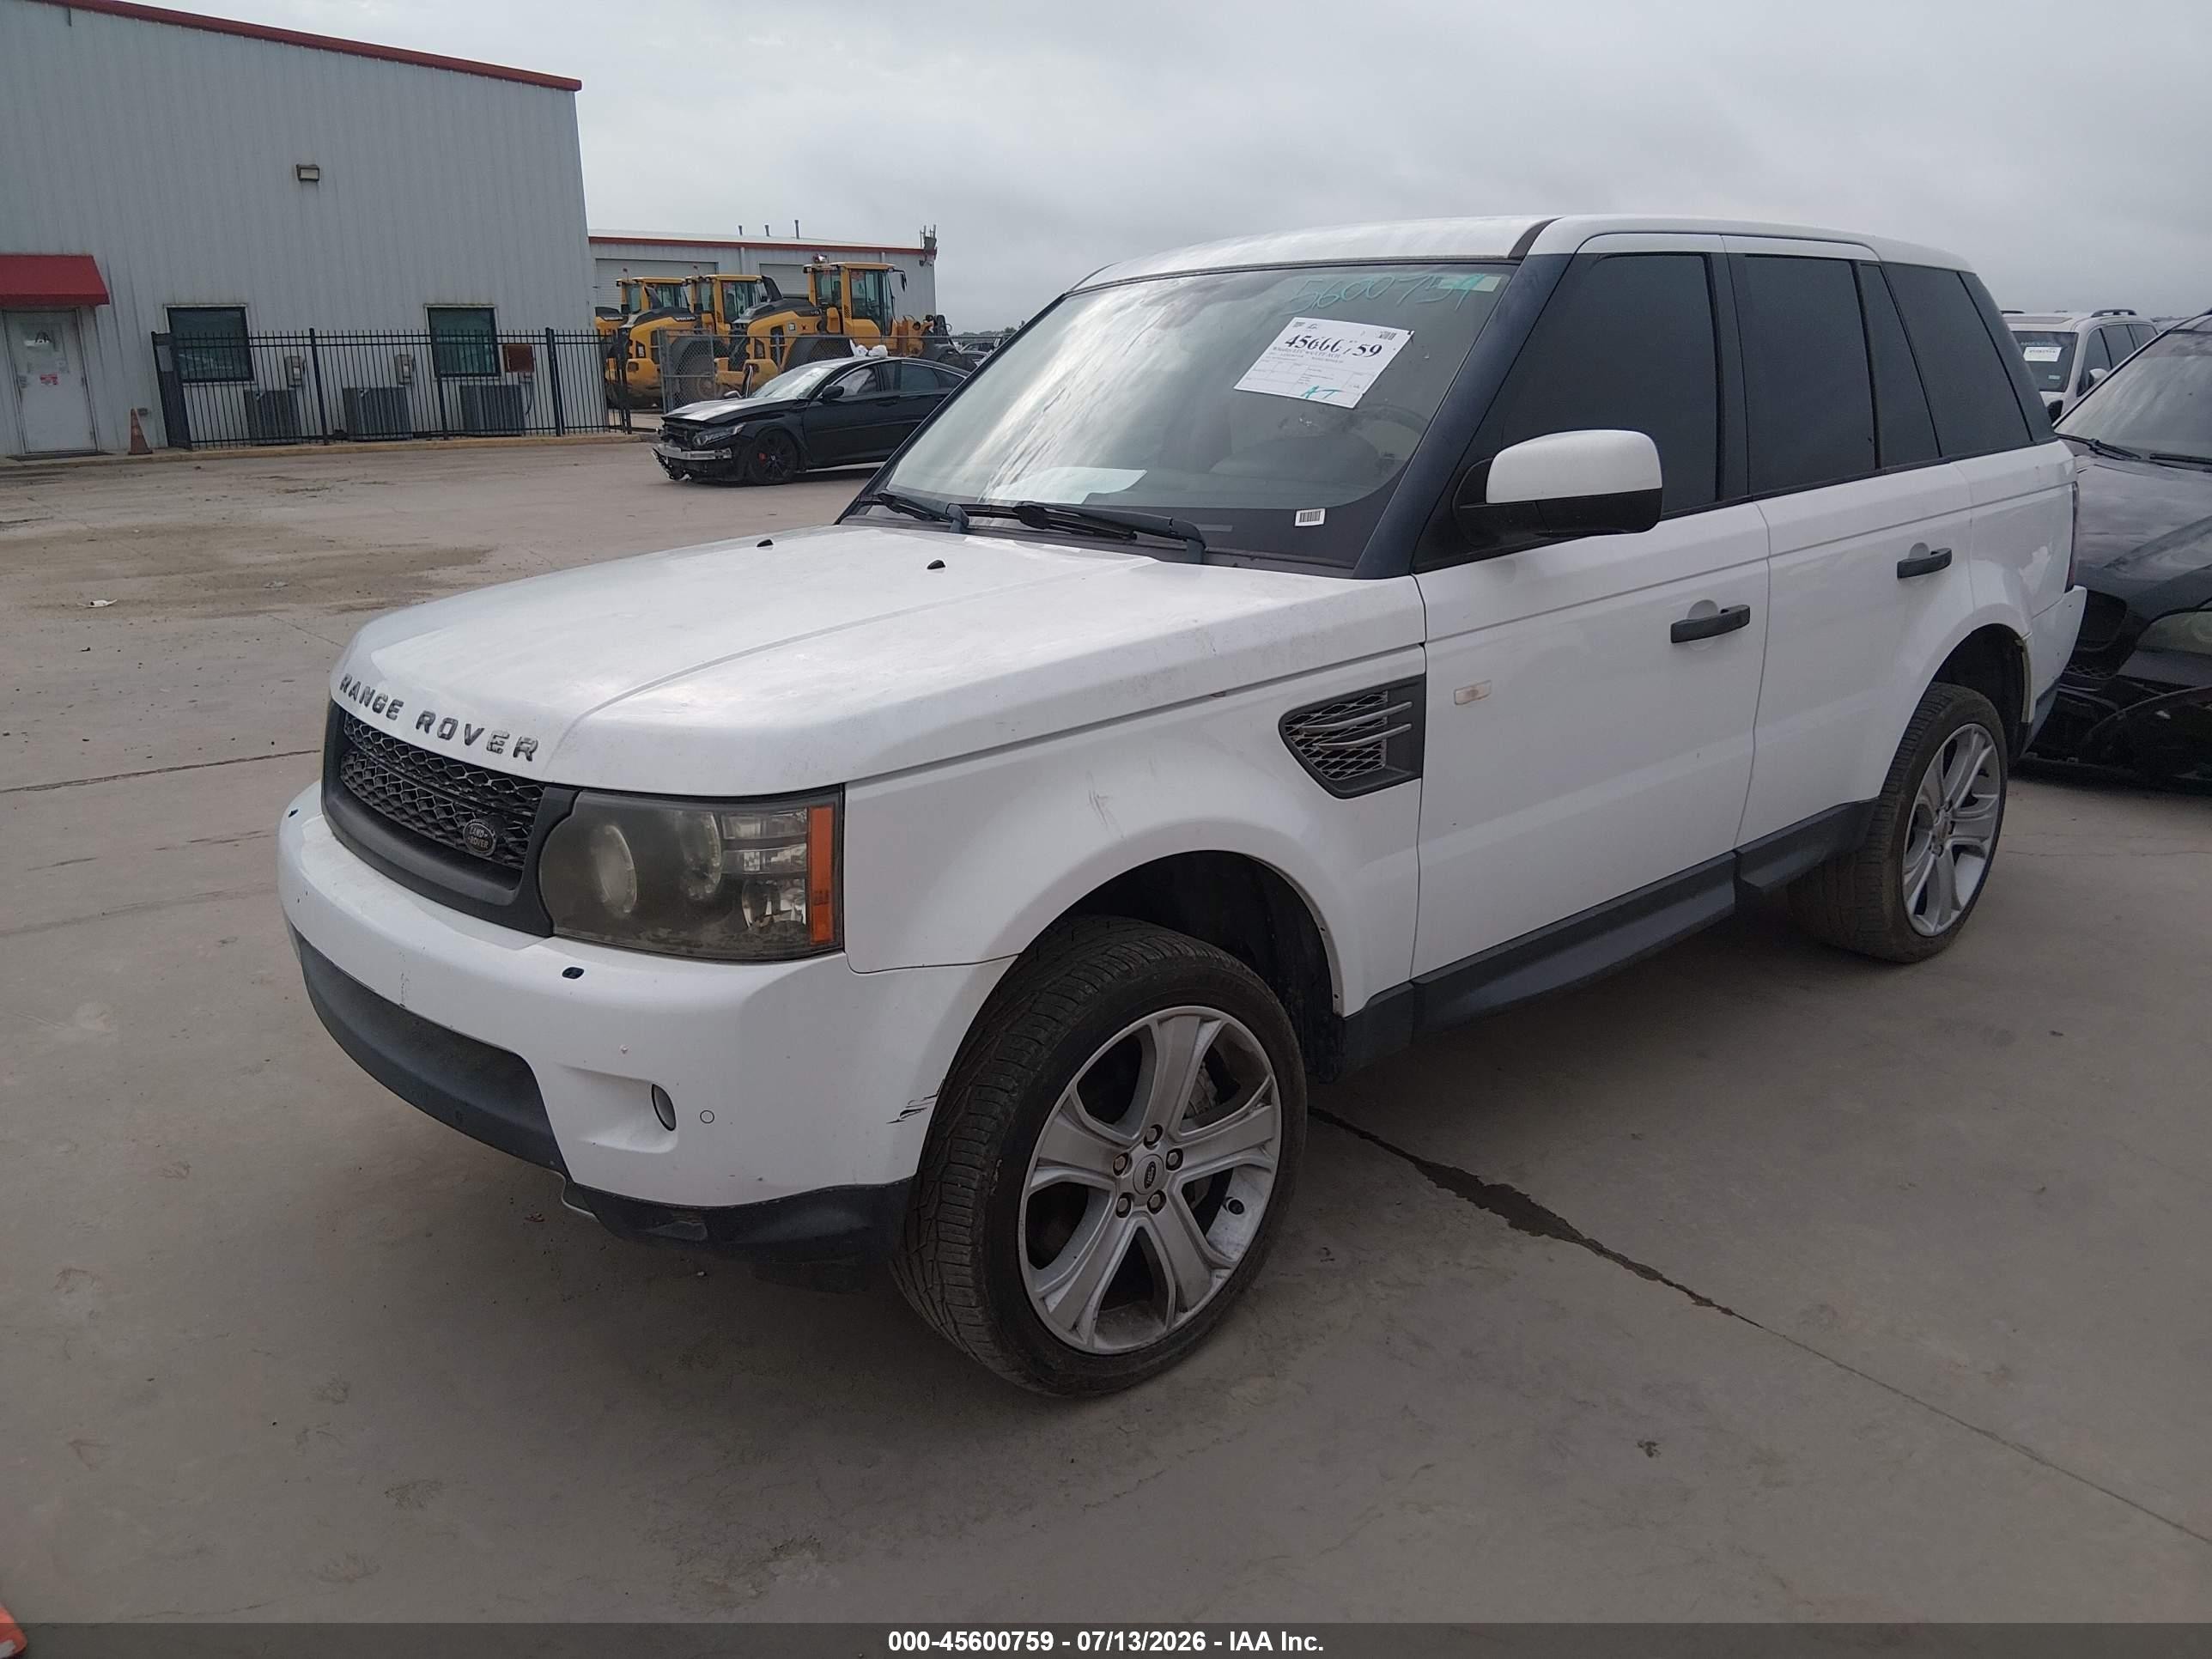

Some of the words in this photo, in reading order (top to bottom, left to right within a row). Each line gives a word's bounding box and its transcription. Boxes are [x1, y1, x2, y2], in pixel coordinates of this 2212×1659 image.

[340, 673, 404, 720] RANGE
[416, 710, 538, 762] ROVER
[470, 826, 484, 838] LAND
[470, 836, 489, 849] ROVER
